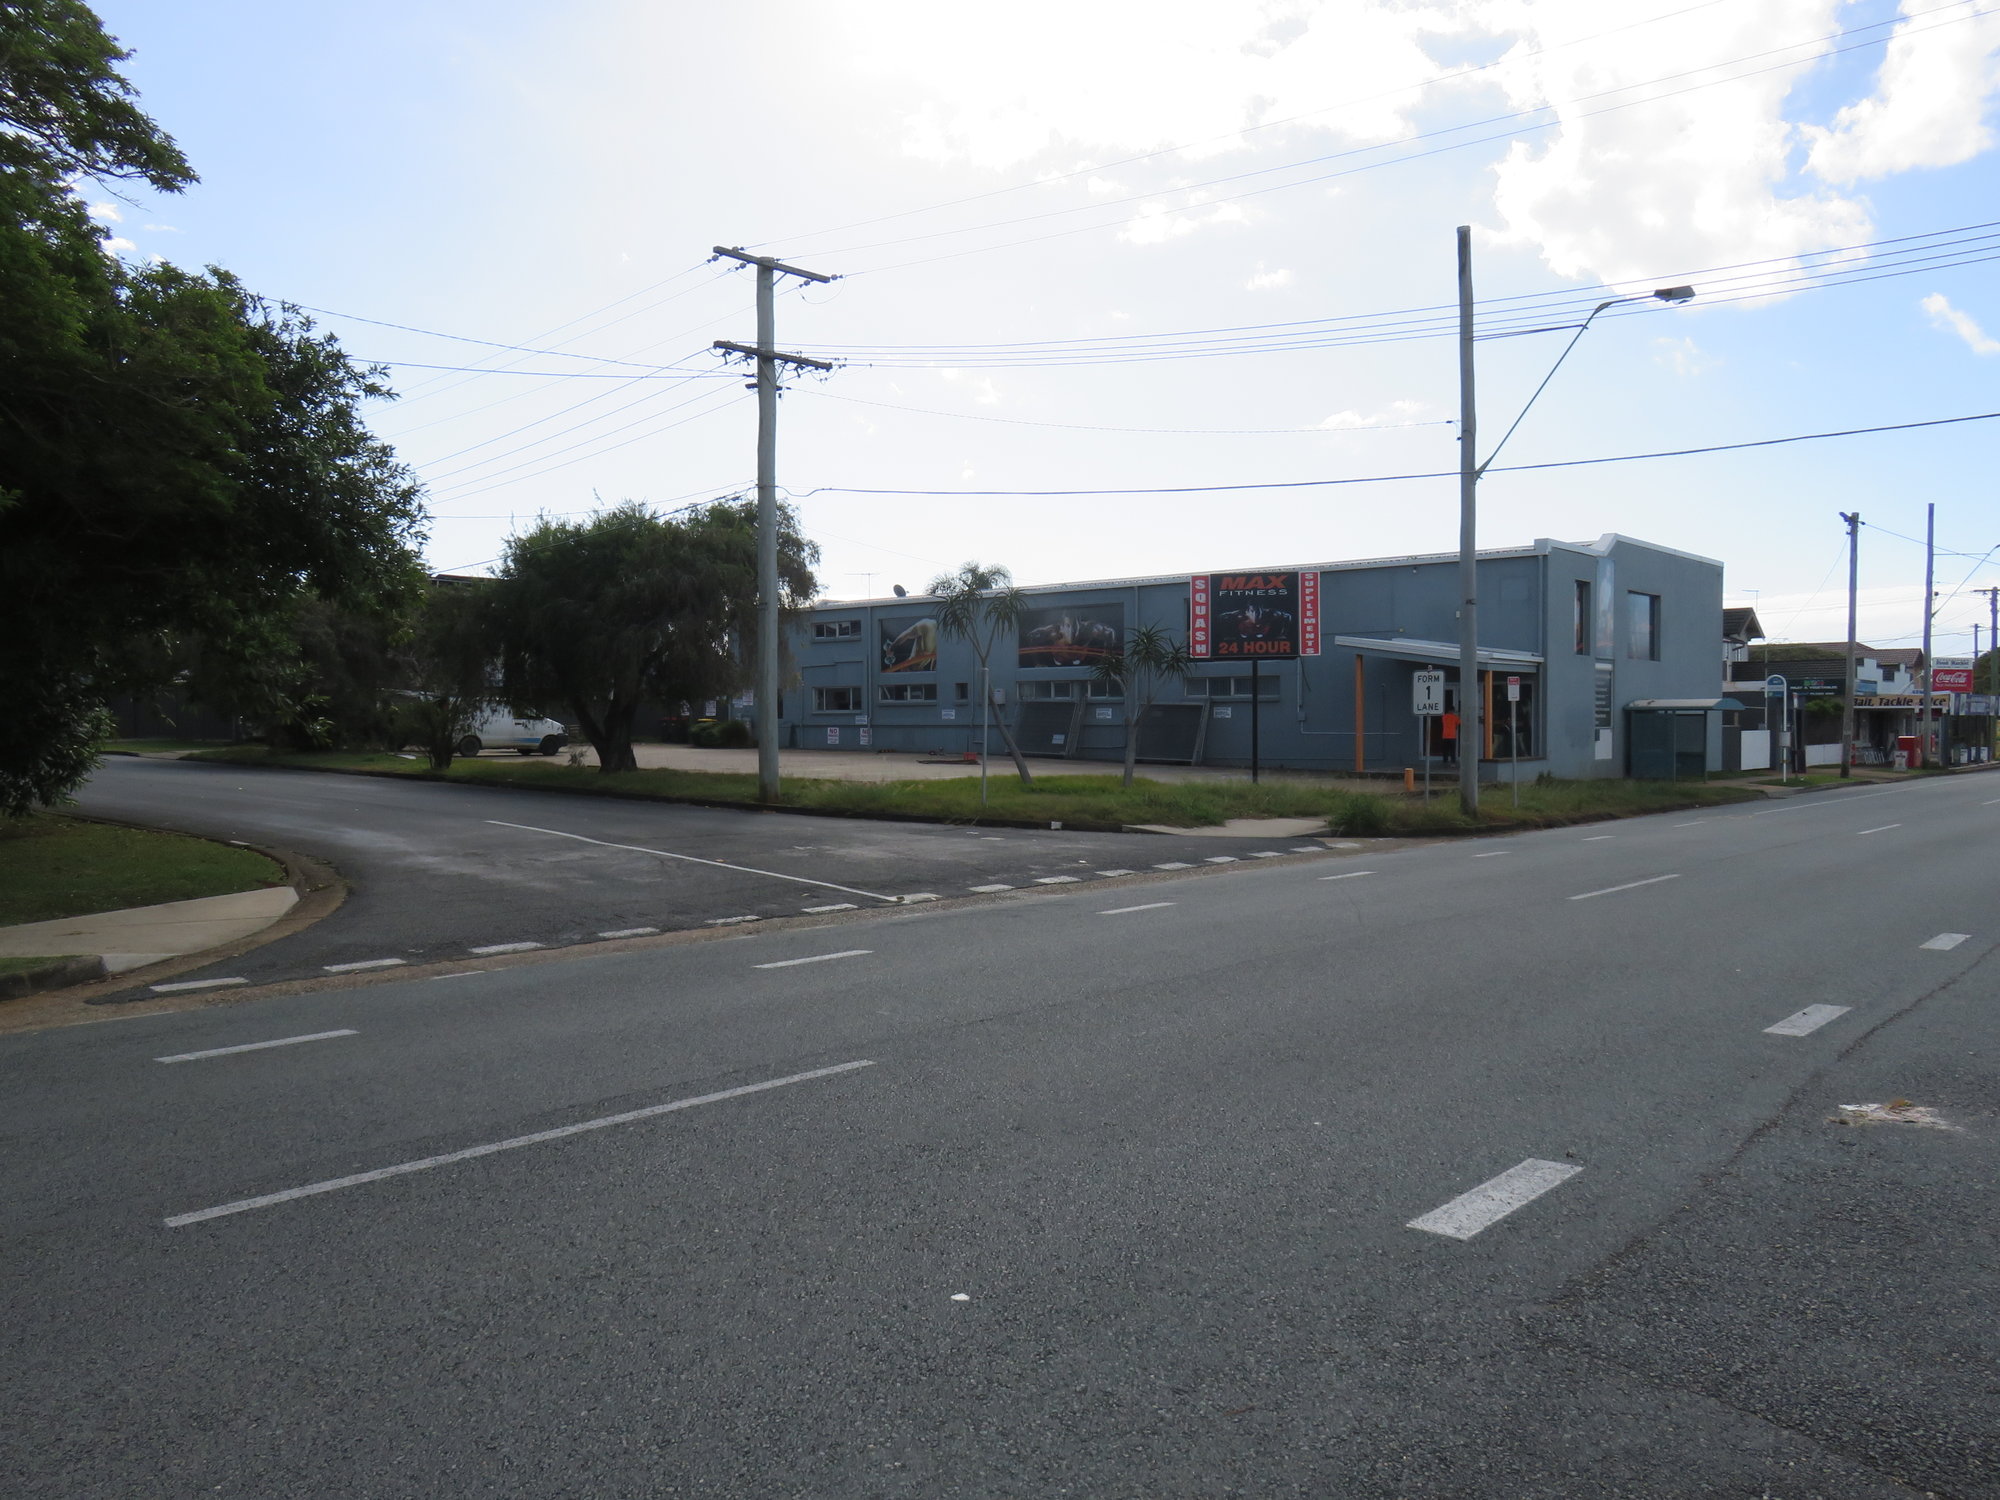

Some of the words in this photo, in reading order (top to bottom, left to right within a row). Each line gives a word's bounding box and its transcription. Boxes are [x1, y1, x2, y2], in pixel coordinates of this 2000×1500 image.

[1221, 576, 1287, 589] MAX
[1195, 579, 1206, 653] SQUASH
[1304, 573, 1315, 654] SUPPLEMENTS
[1219, 642, 1239, 654] 24
[1243, 641, 1291, 654] HOUR
[1417, 675, 1440, 683] FORM
[1426, 685, 1431, 700] 1
[1417, 703, 1439, 711] LANE
[1879, 697, 1913, 707] Tackle
